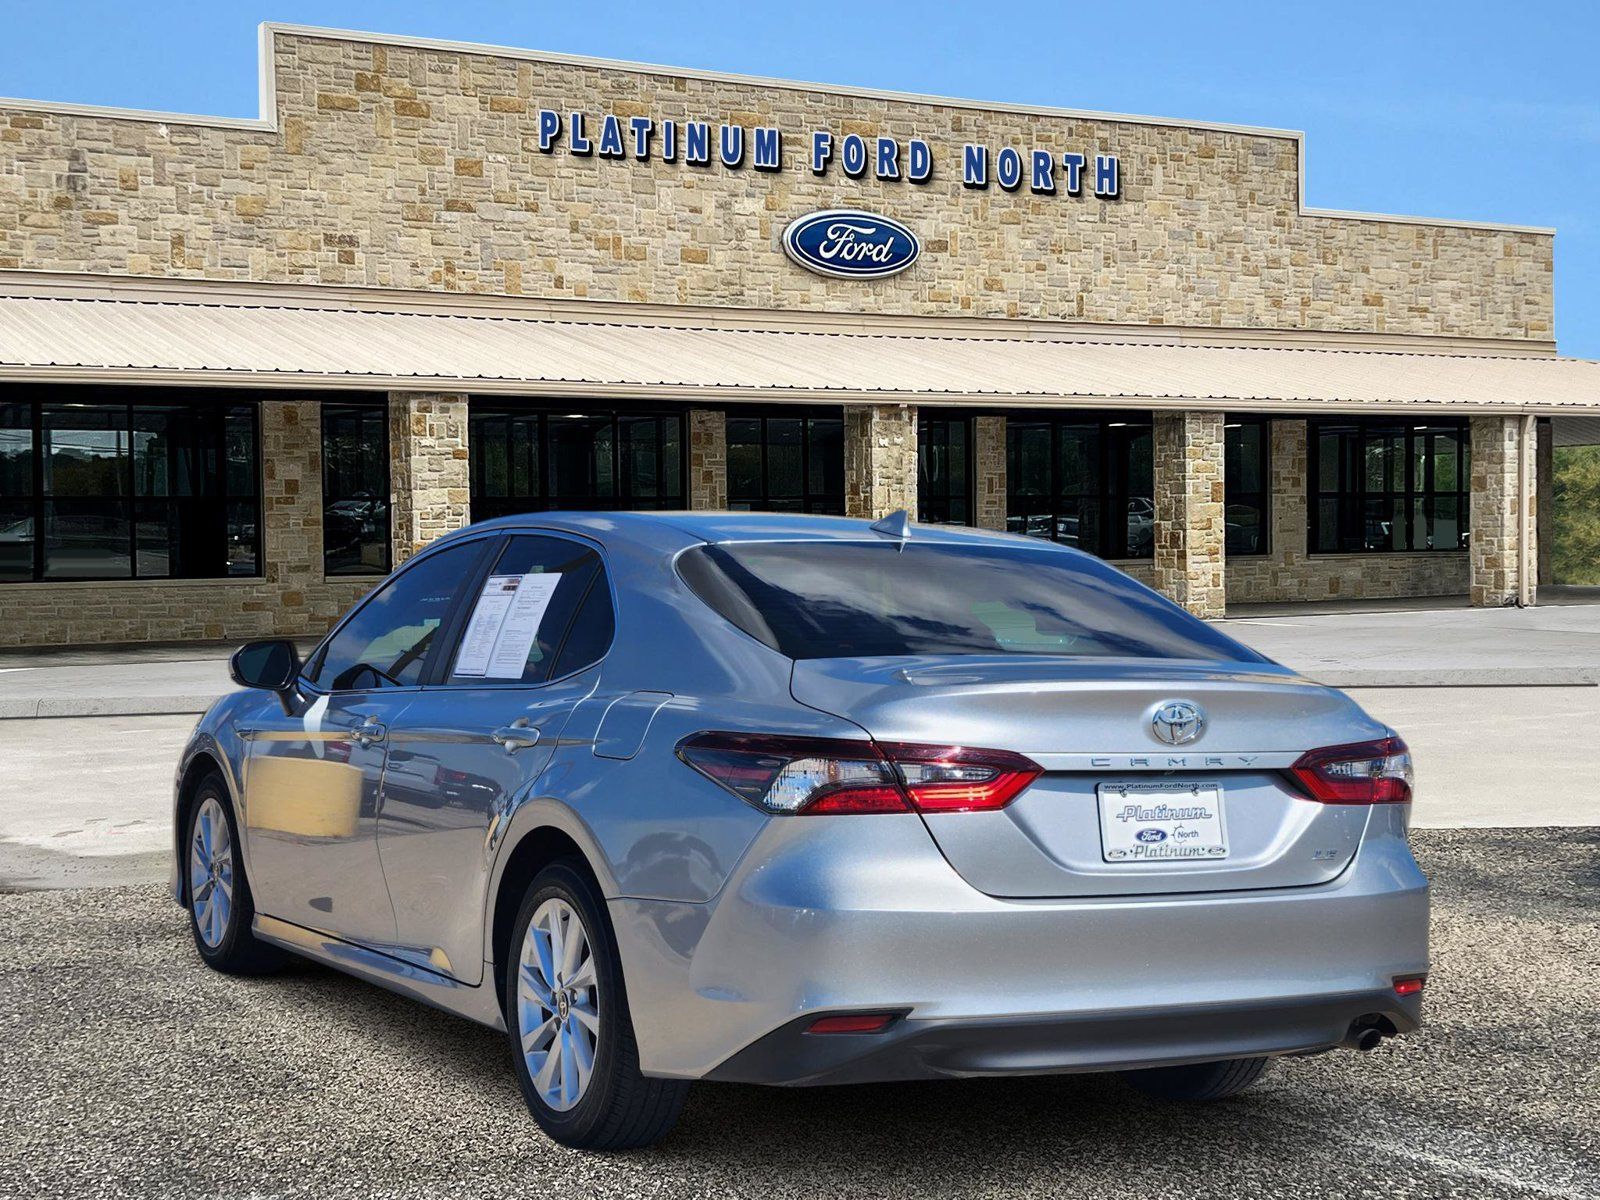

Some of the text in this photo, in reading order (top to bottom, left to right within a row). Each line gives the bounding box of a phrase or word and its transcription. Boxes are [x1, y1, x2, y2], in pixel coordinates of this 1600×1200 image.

[538, 109, 1119, 198] PLATINUM FORD NORTH
[819, 223, 894, 262] Ford
[1091, 756, 1259, 767] CAMRY
[1104, 782, 1218, 790] www.PlatinumFordNorth.com
[1116, 804, 1213, 822] Platinum
[1140, 830, 1162, 841] Ford
[1177, 830, 1199, 838] North
[1133, 844, 1204, 859] Platinum
